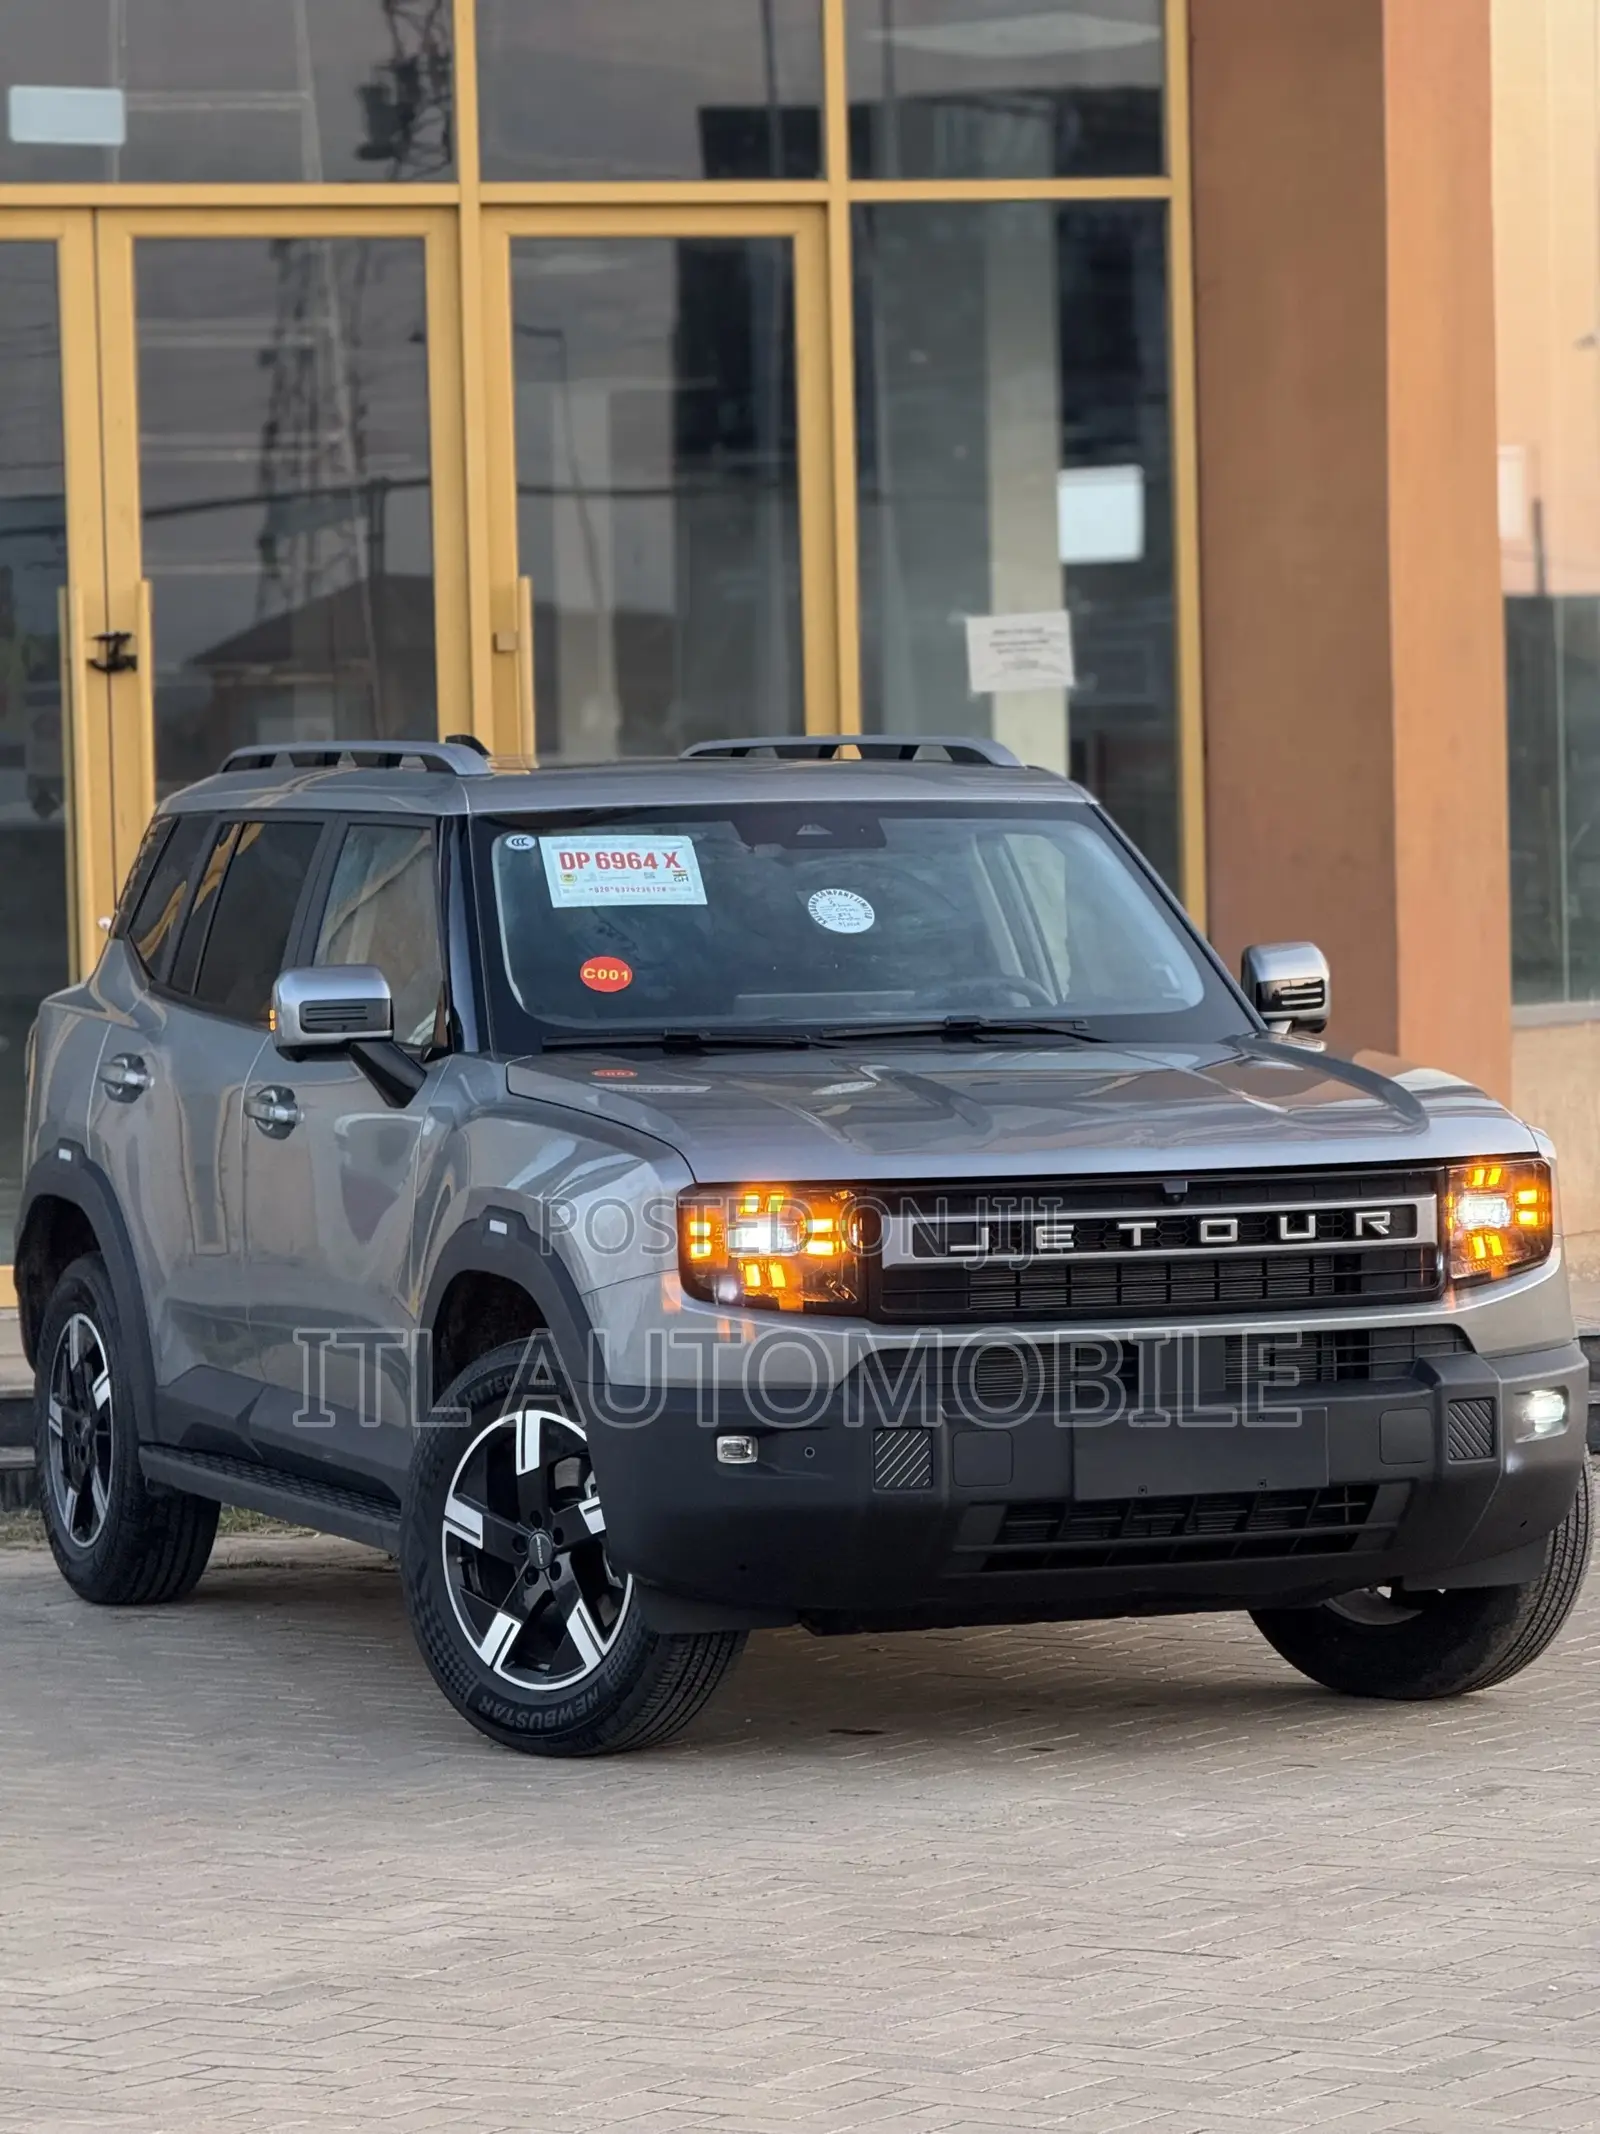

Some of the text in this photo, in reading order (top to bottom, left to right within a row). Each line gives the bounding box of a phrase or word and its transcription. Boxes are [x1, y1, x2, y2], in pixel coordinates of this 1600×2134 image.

[559, 851, 681, 871] DP 6964 X
[583, 967, 629, 982] C001
[949, 1210, 1391, 1253] JETOUR
[478, 1686, 600, 1730] NEWBUSTAR
